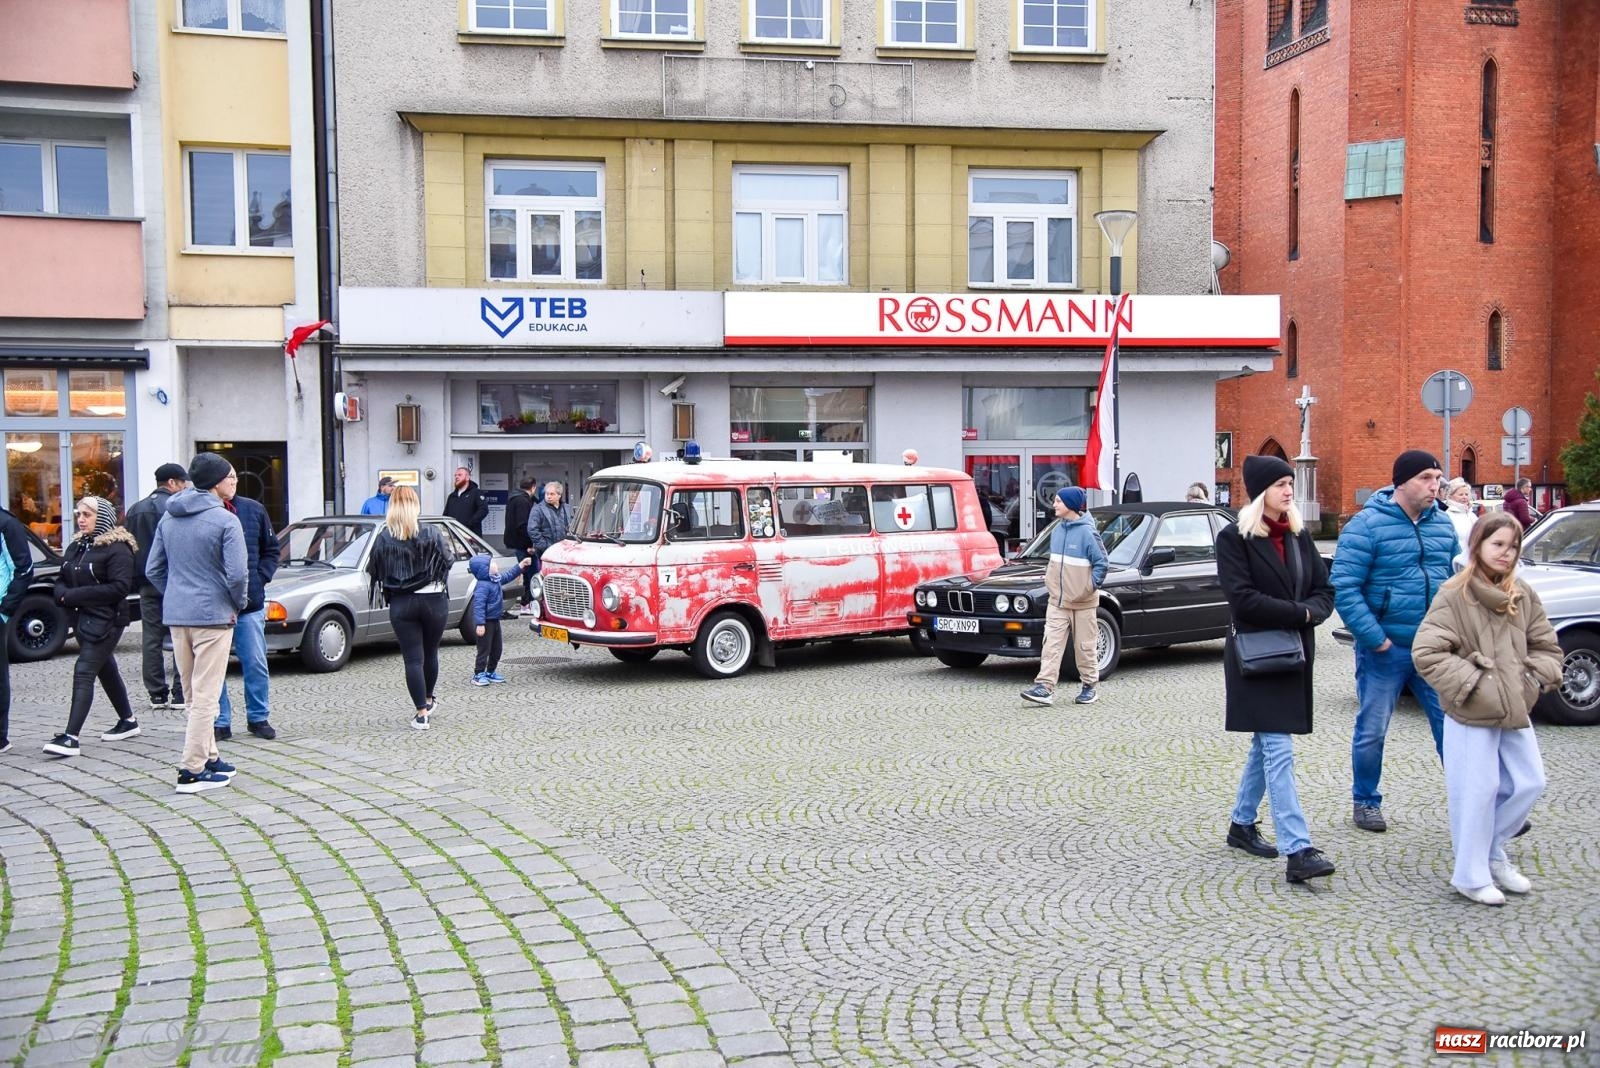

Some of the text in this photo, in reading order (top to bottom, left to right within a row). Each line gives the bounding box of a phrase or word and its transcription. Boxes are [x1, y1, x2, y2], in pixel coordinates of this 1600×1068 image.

[529, 297, 588, 318] TEB
[878, 297, 1133, 333] ROSSMANN
[529, 323, 588, 332] EDUKACJA
[664, 574, 671, 583] 7
[938, 618, 977, 631] SRC XN99
